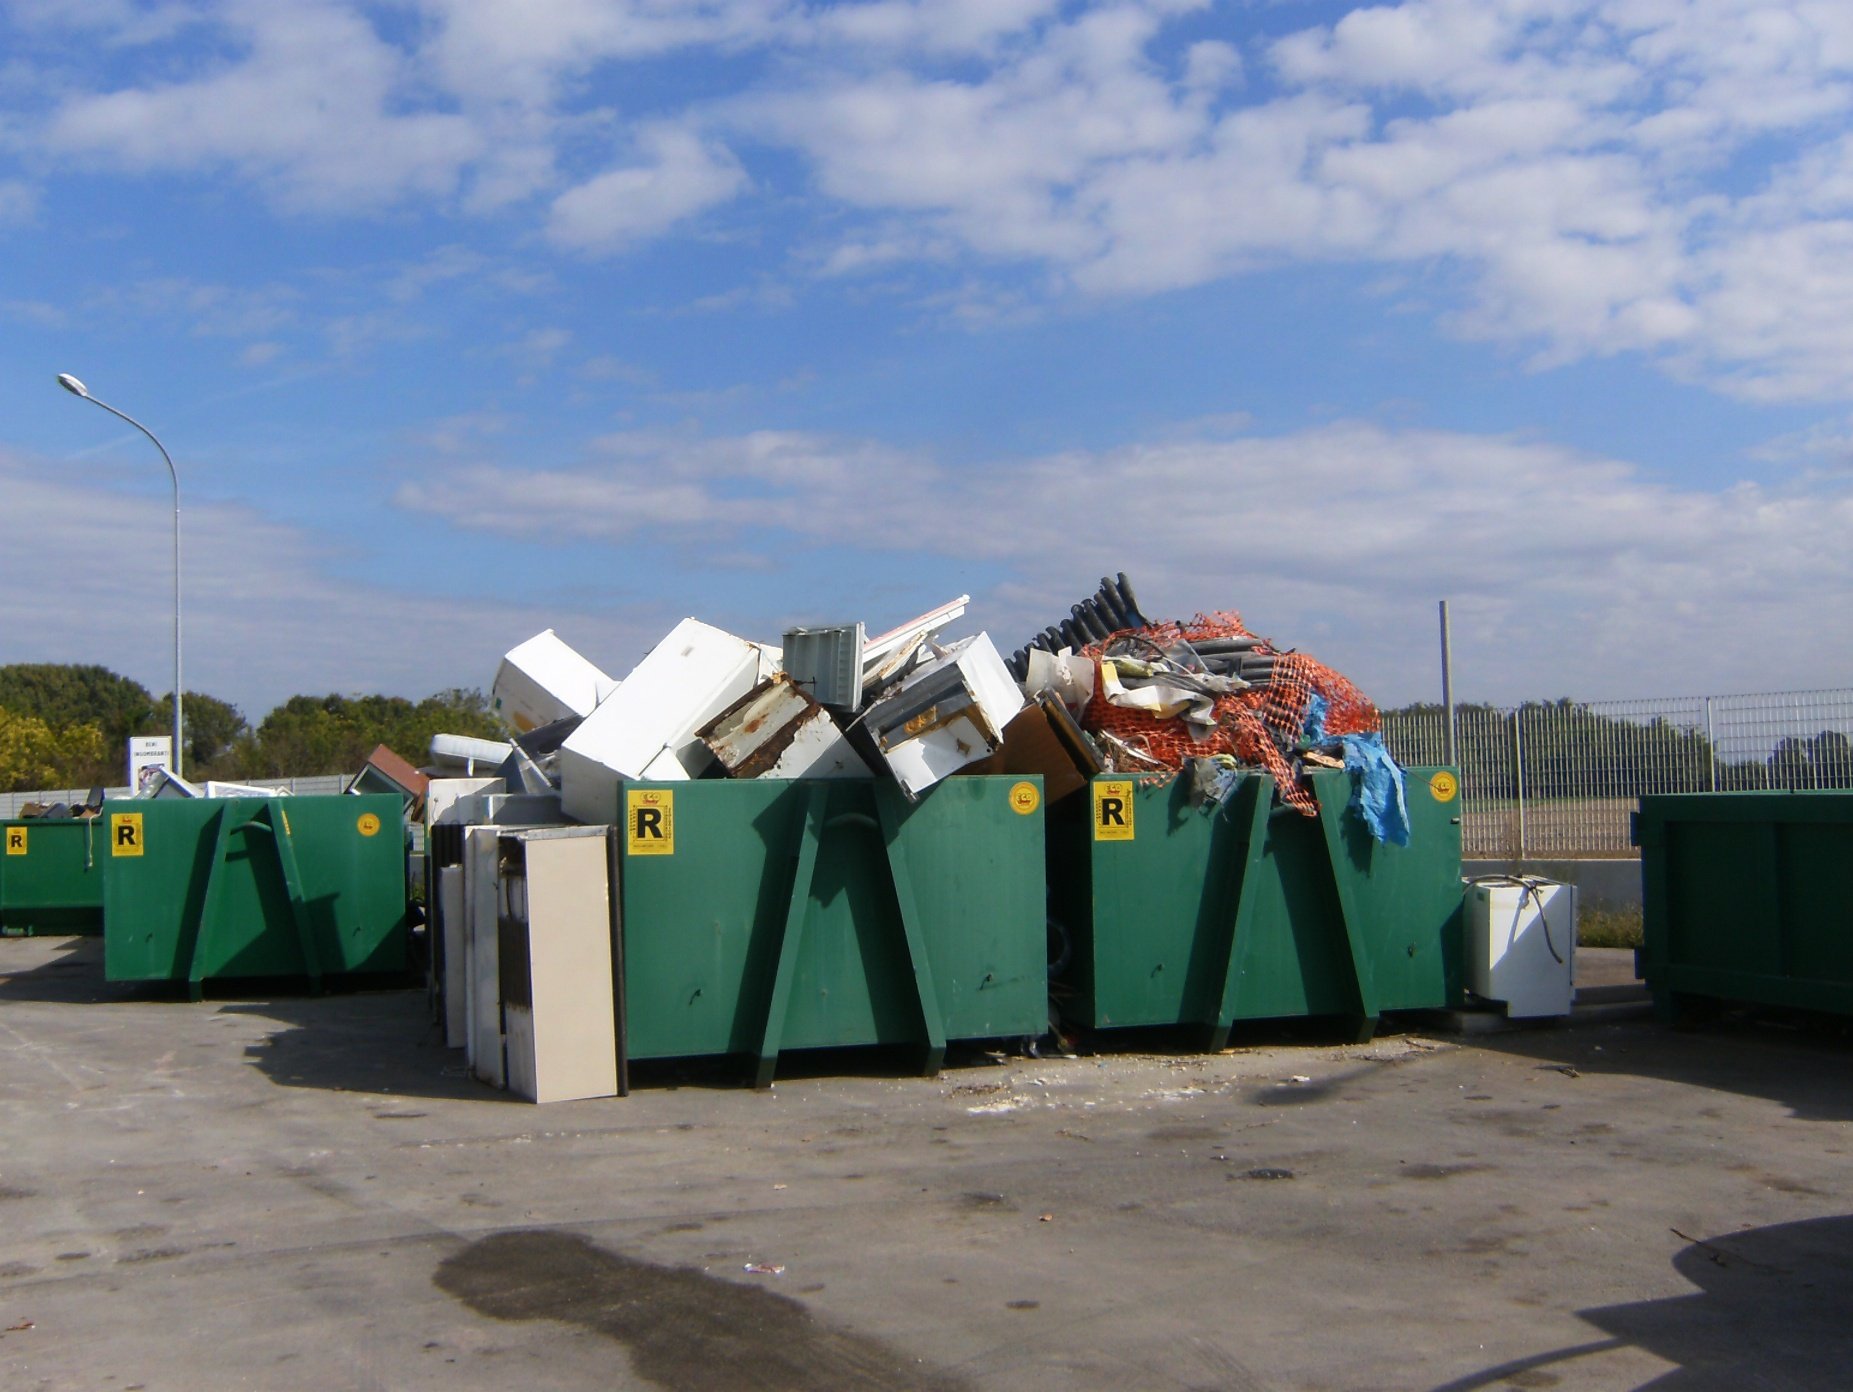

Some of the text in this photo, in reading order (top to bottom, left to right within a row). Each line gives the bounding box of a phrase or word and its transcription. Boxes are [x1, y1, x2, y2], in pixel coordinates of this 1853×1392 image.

[637, 808, 663, 838] R
[1102, 798, 1125, 825] R
[11, 835, 22, 847] R
[118, 825, 136, 845] R
